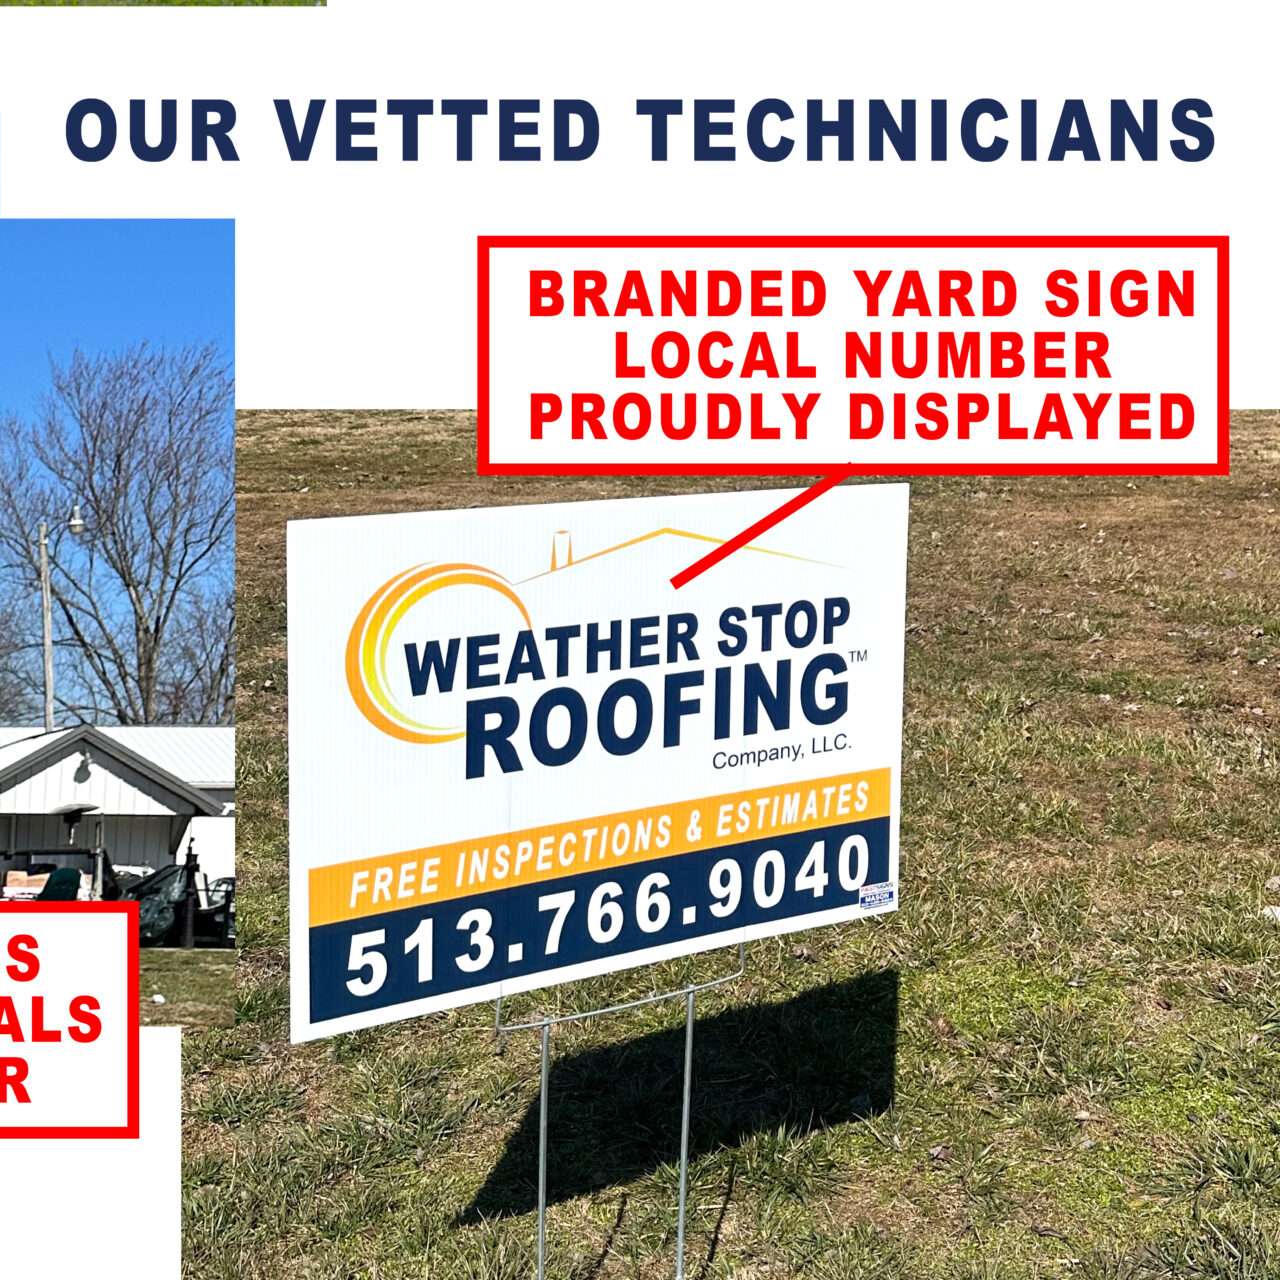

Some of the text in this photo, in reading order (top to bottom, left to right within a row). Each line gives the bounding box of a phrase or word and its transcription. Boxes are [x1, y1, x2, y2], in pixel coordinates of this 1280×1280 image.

[404, 597, 851, 697] WEATHER STOP
[466, 652, 849, 780] ROOFING
[712, 733, 853, 770] Company, LLC.
[349, 781, 869, 908] FREE INSPECTIONS & ESTIMATES
[346, 834, 869, 997] 513.766.9040
